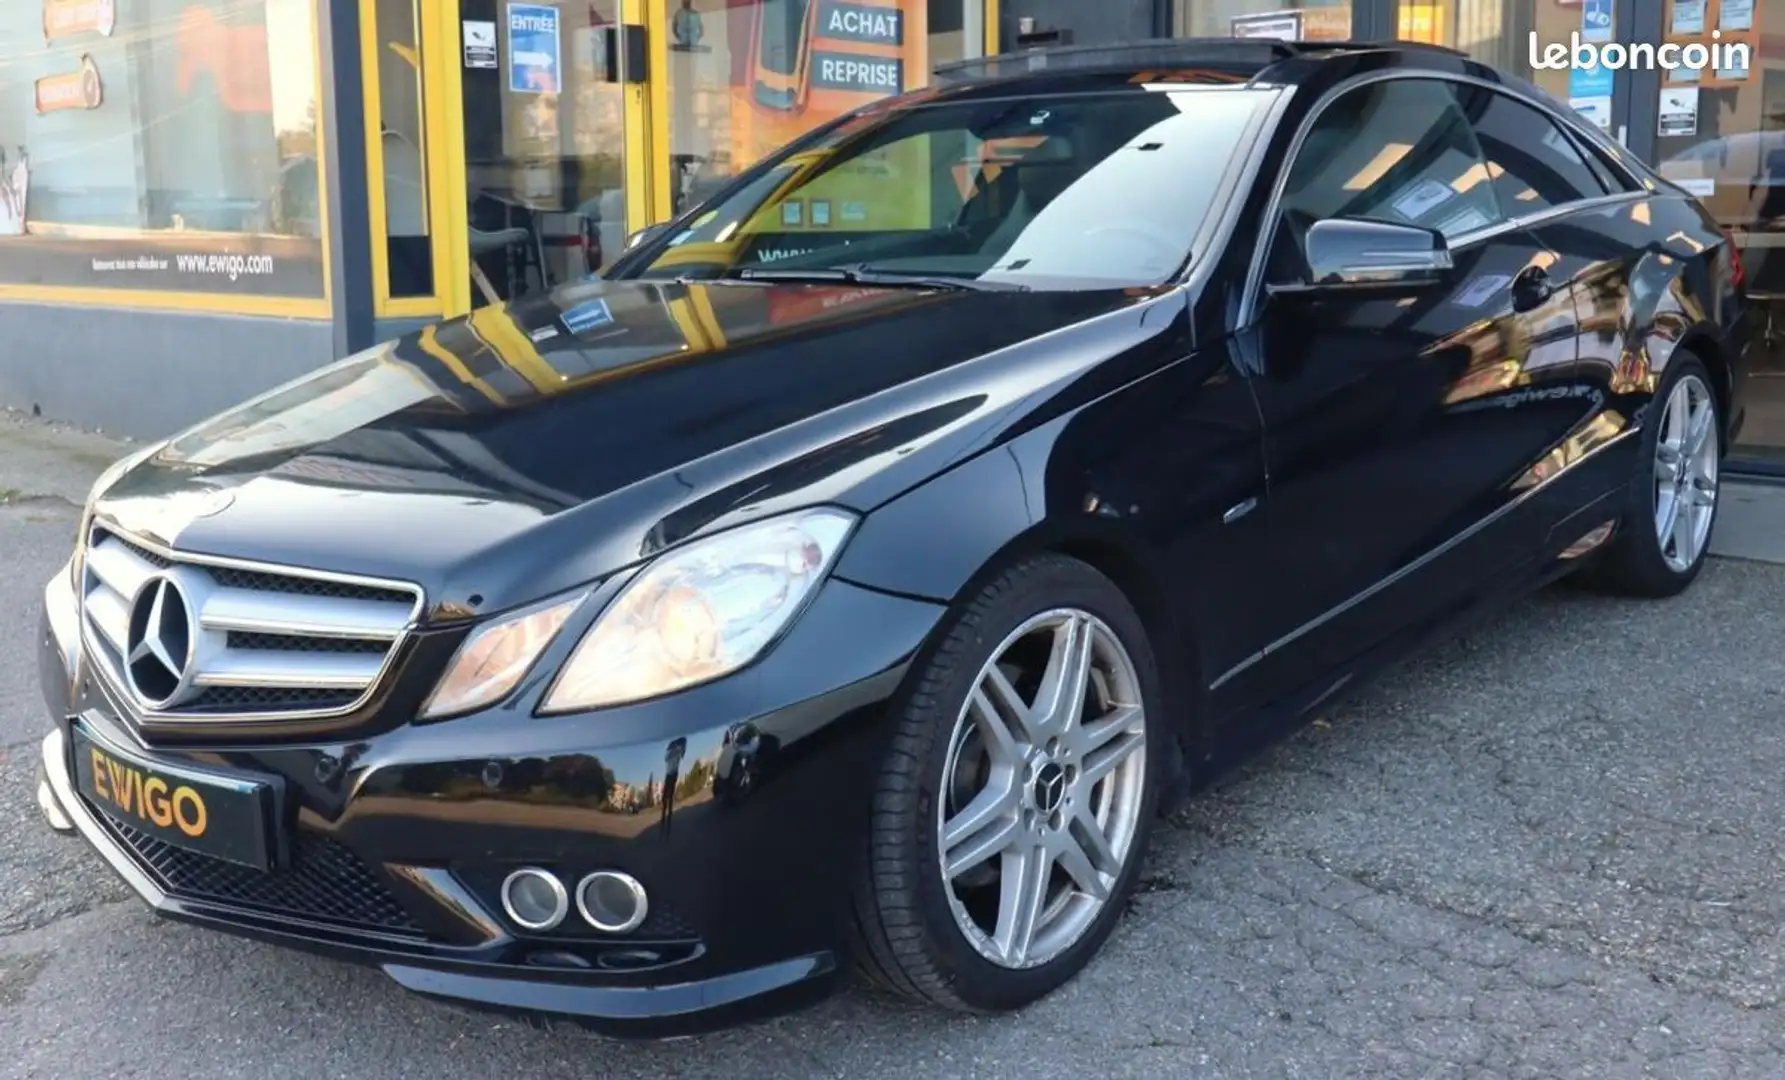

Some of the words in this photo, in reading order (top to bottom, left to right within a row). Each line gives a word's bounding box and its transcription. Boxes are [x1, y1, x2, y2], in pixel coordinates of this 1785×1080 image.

[511, 12, 555, 33] ENTRÉE
[828, 9, 898, 37] ACHAT
[822, 59, 898, 87] REPRISE
[176, 247, 274, 281] www.ewigo.com
[90, 748, 208, 837] EWIGO
